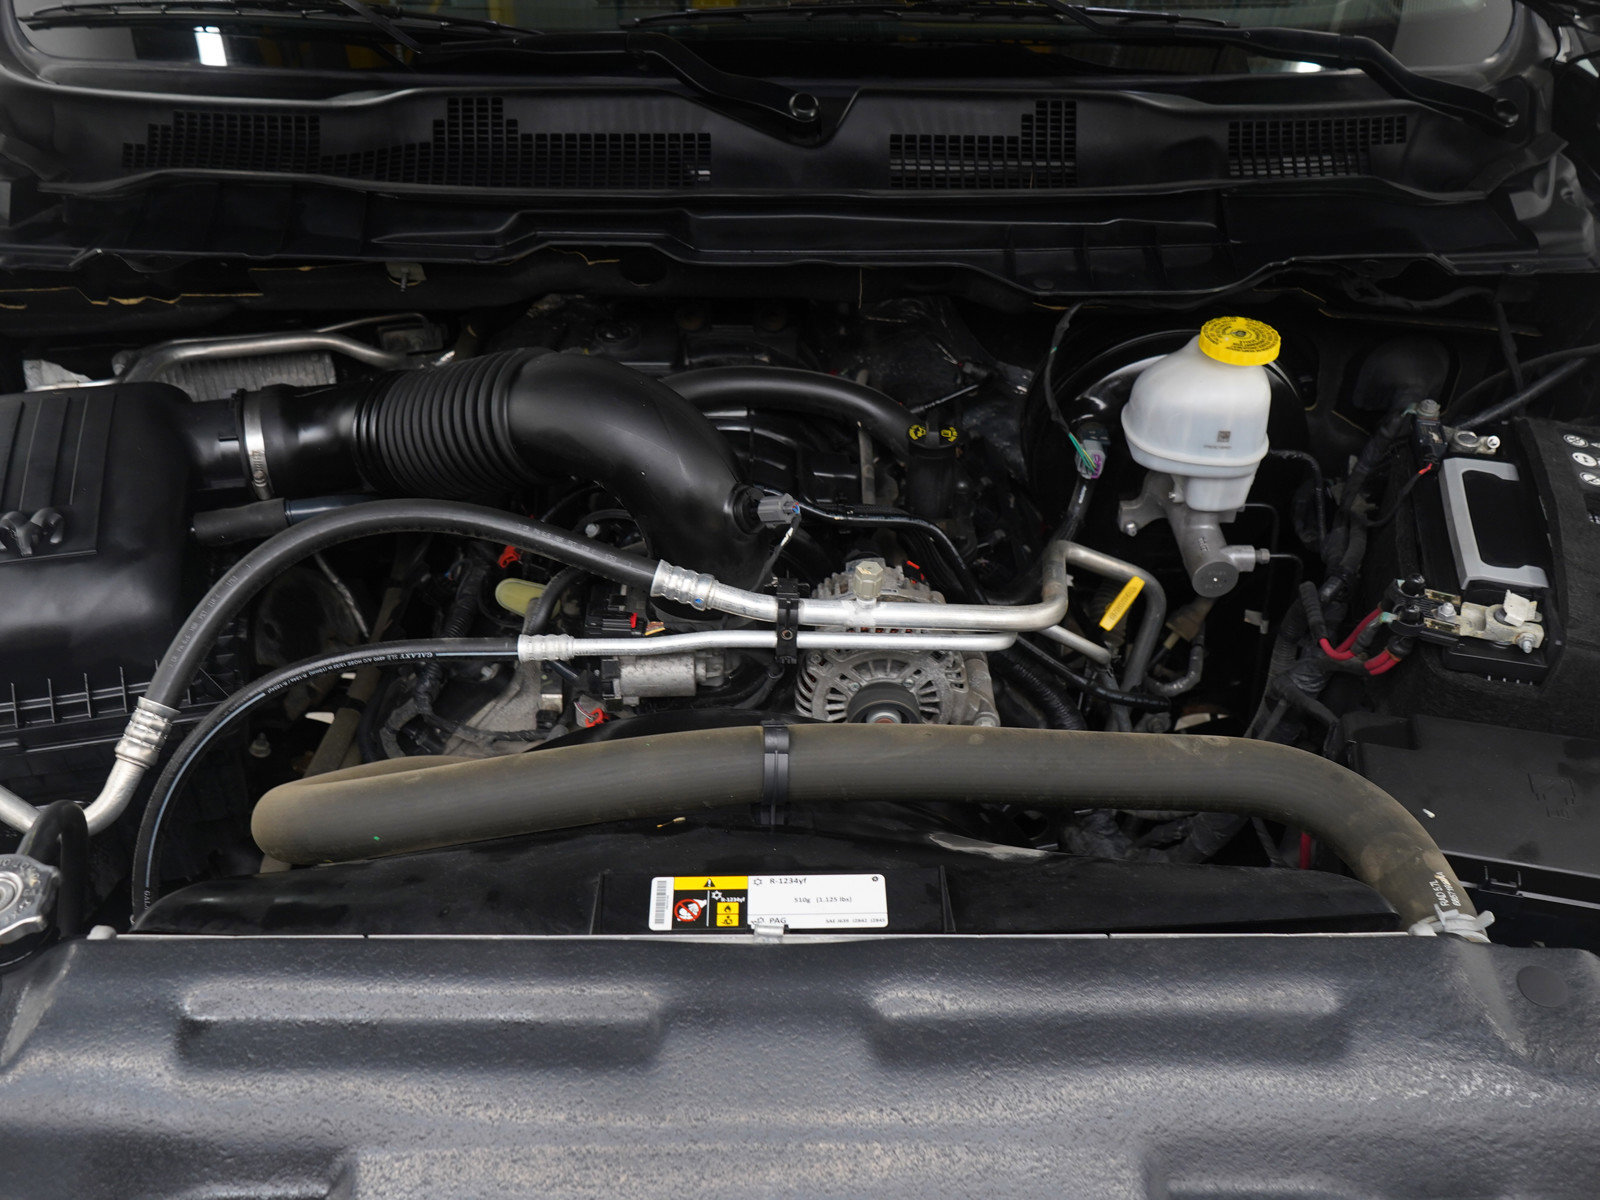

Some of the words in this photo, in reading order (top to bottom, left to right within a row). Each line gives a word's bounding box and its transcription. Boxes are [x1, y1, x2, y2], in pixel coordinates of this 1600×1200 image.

[399, 651, 433, 660] GALAXY
[347, 659, 363, 667] HOSE
[769, 877, 807, 885] R-1234yf
[794, 896, 811, 904] 510g
